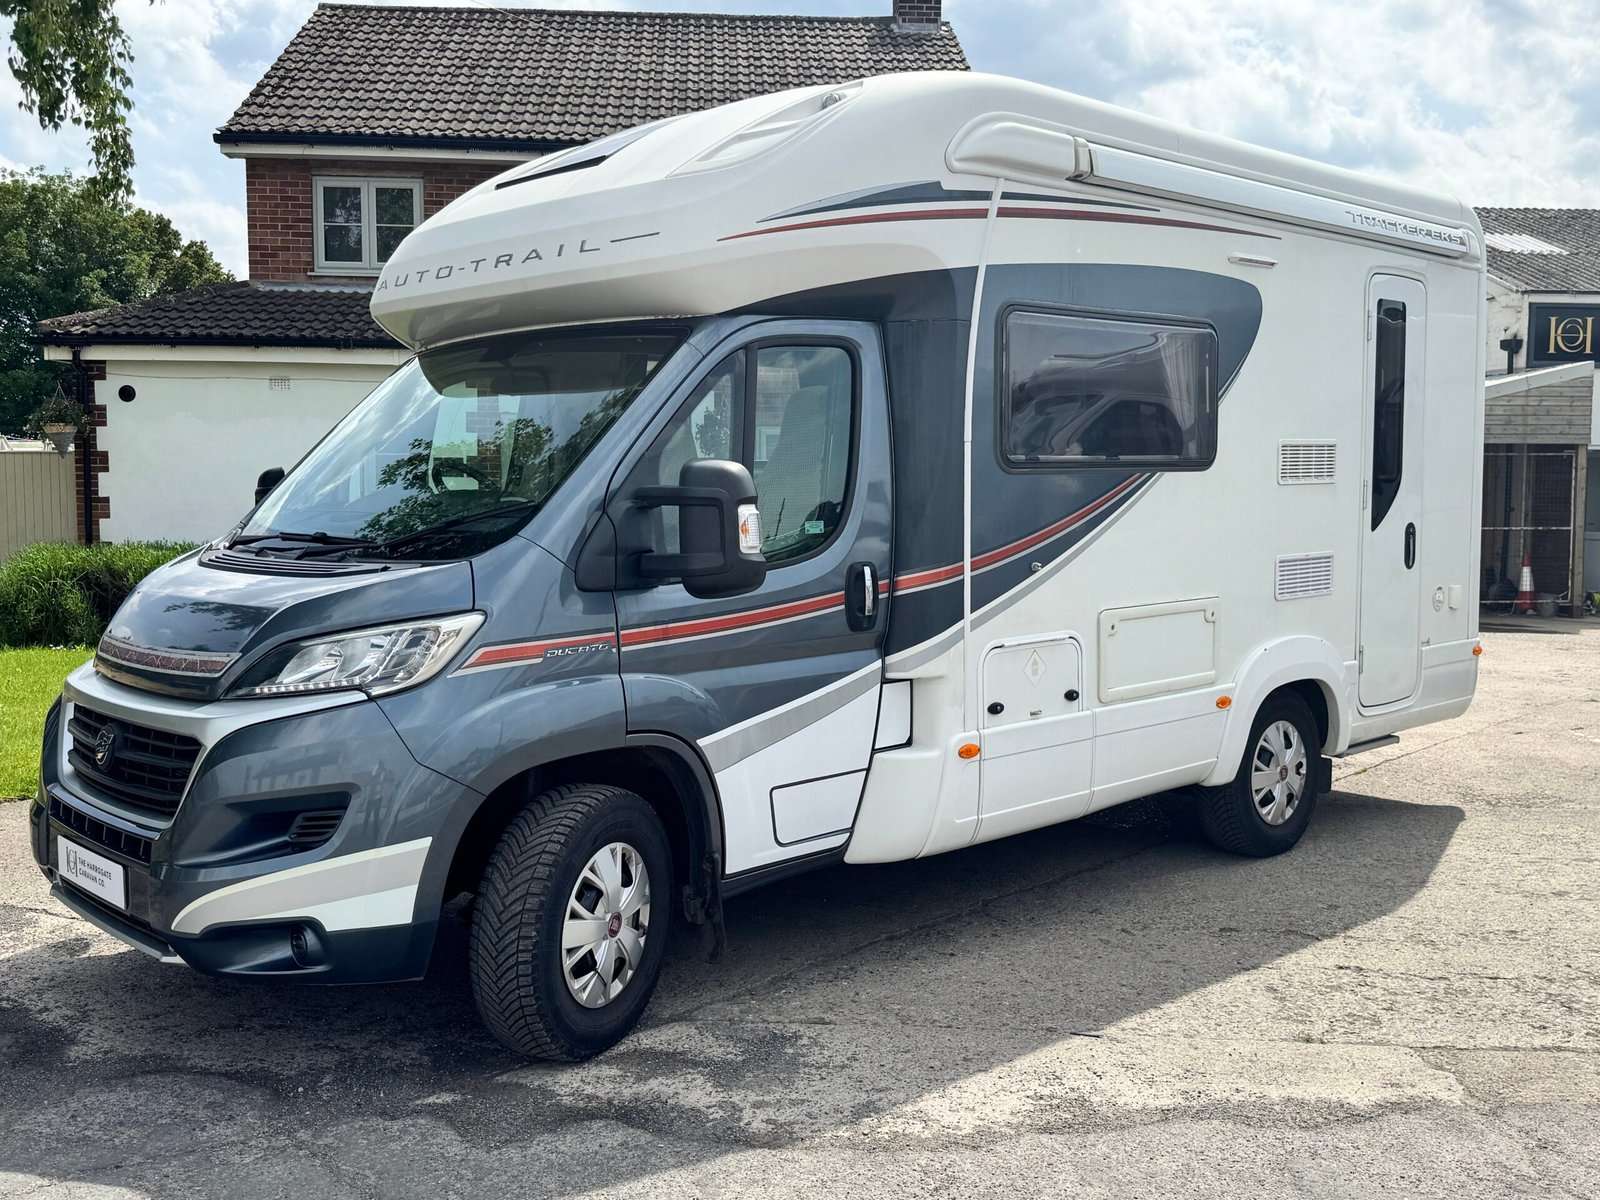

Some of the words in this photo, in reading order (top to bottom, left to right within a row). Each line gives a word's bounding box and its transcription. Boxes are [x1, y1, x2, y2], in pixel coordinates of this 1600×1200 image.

[377, 239, 601, 292] AUTO-TRAIL
[78, 857, 86, 867] THE
[86, 863, 112, 881] HARROGATE
[79, 867, 98, 884] CARAVAN
